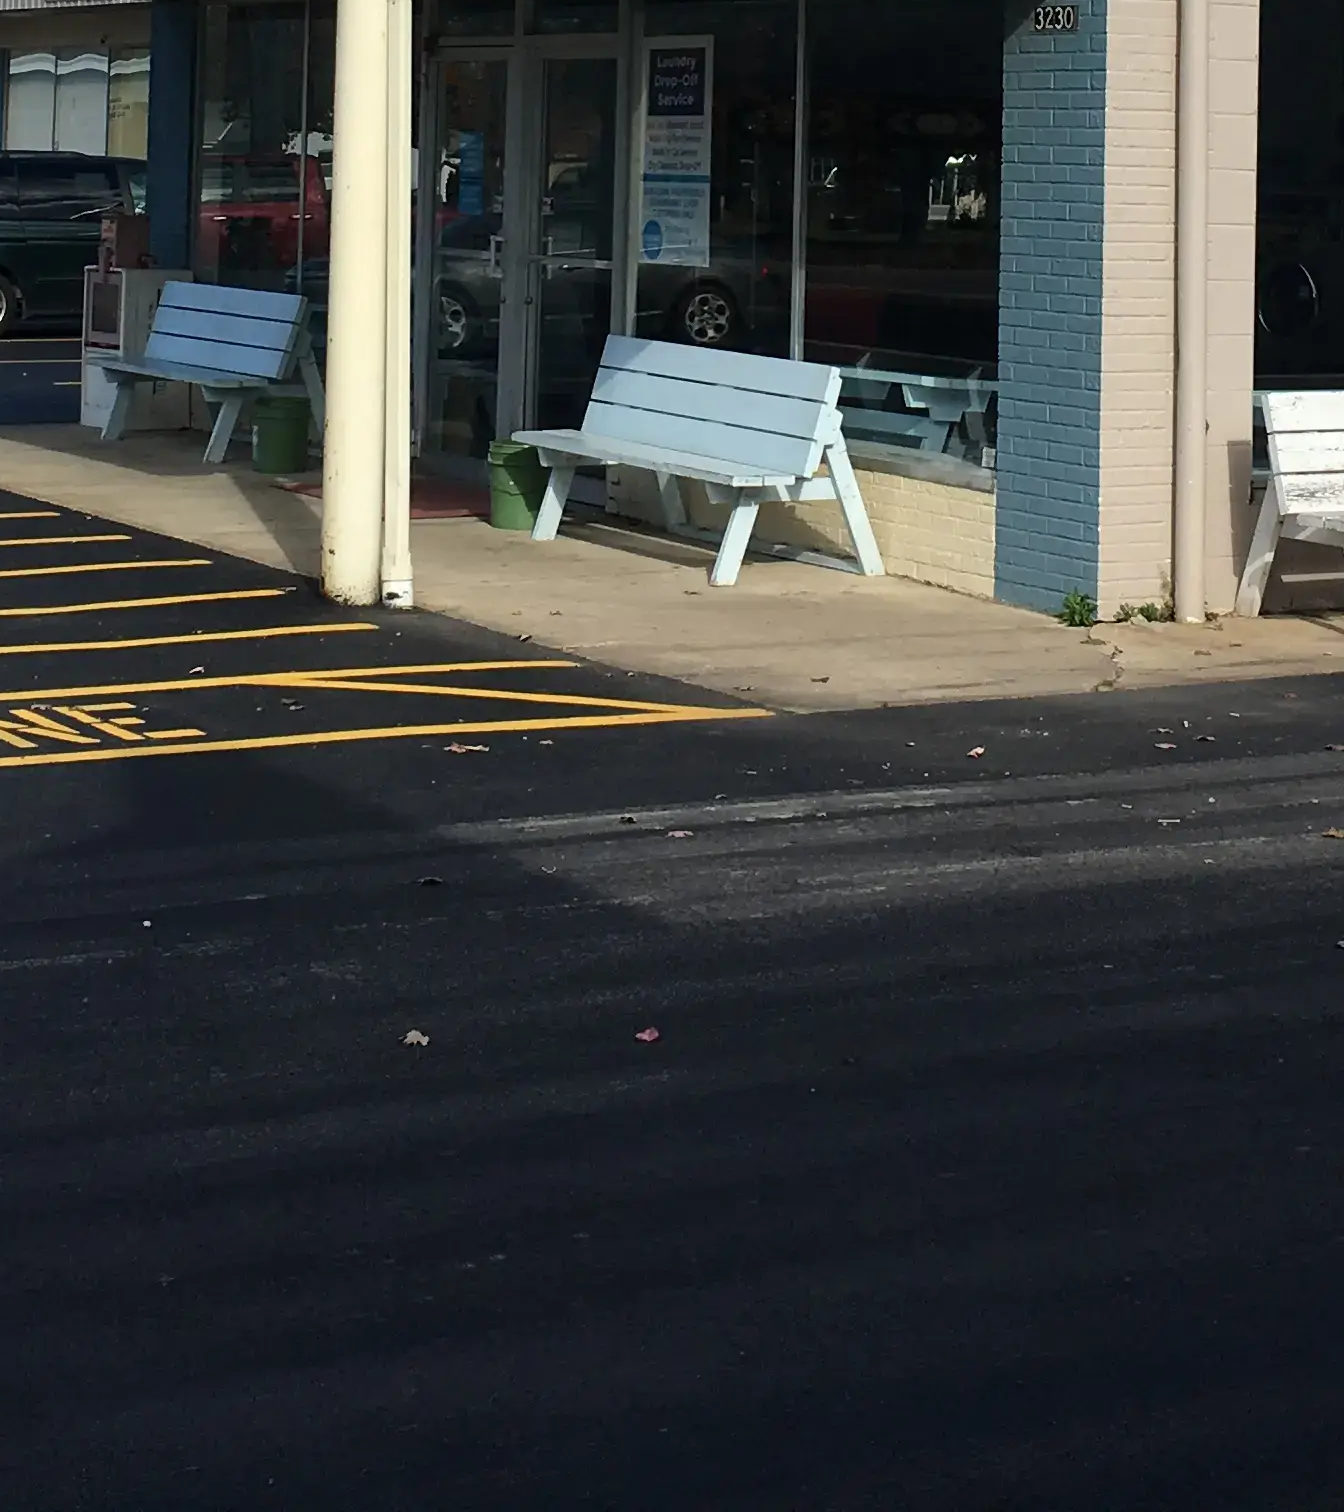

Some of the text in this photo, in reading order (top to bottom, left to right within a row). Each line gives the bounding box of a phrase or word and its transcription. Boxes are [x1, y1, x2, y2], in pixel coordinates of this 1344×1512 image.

[1036, 7, 1073, 29] 3230
[657, 55, 697, 71] Laundry
[657, 93, 694, 106] Service
